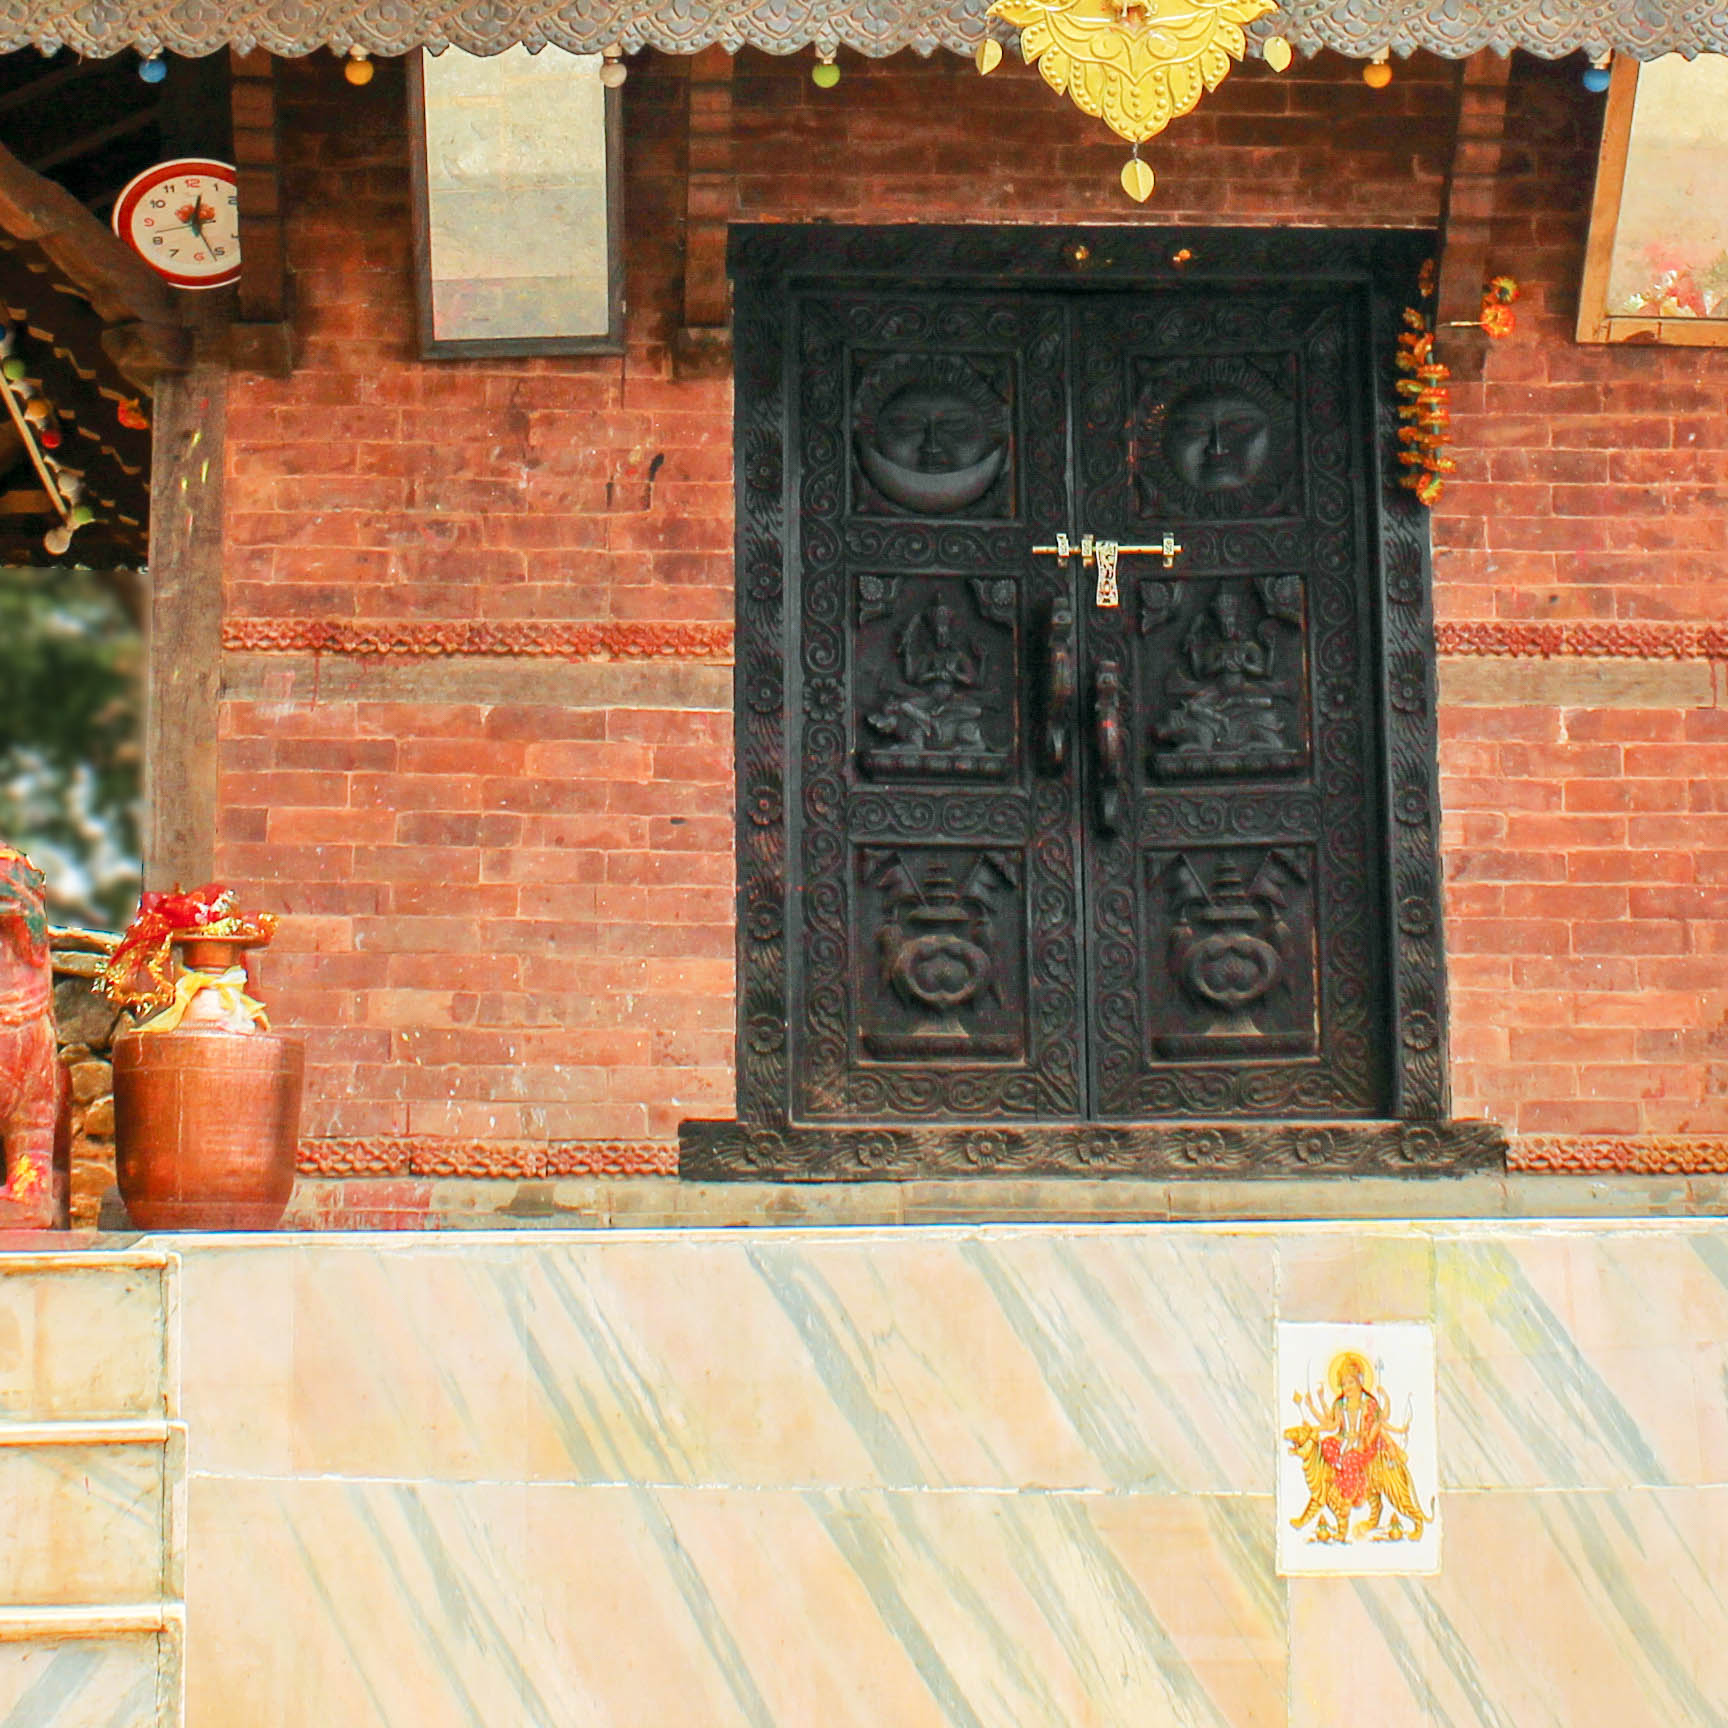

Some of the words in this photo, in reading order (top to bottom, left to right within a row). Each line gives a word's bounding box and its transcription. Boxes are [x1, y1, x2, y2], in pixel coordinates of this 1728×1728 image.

[185, 178, 200, 188] 12
[213, 183, 219, 192] 1
[164, 184, 175, 193] 11
[151, 199, 166, 209] 10
[144, 217, 154, 227] 9
[153, 236, 163, 246] 8
[169, 249, 179, 258] 7
[214, 247, 225, 256] 5
[193, 252, 204, 262] 6
